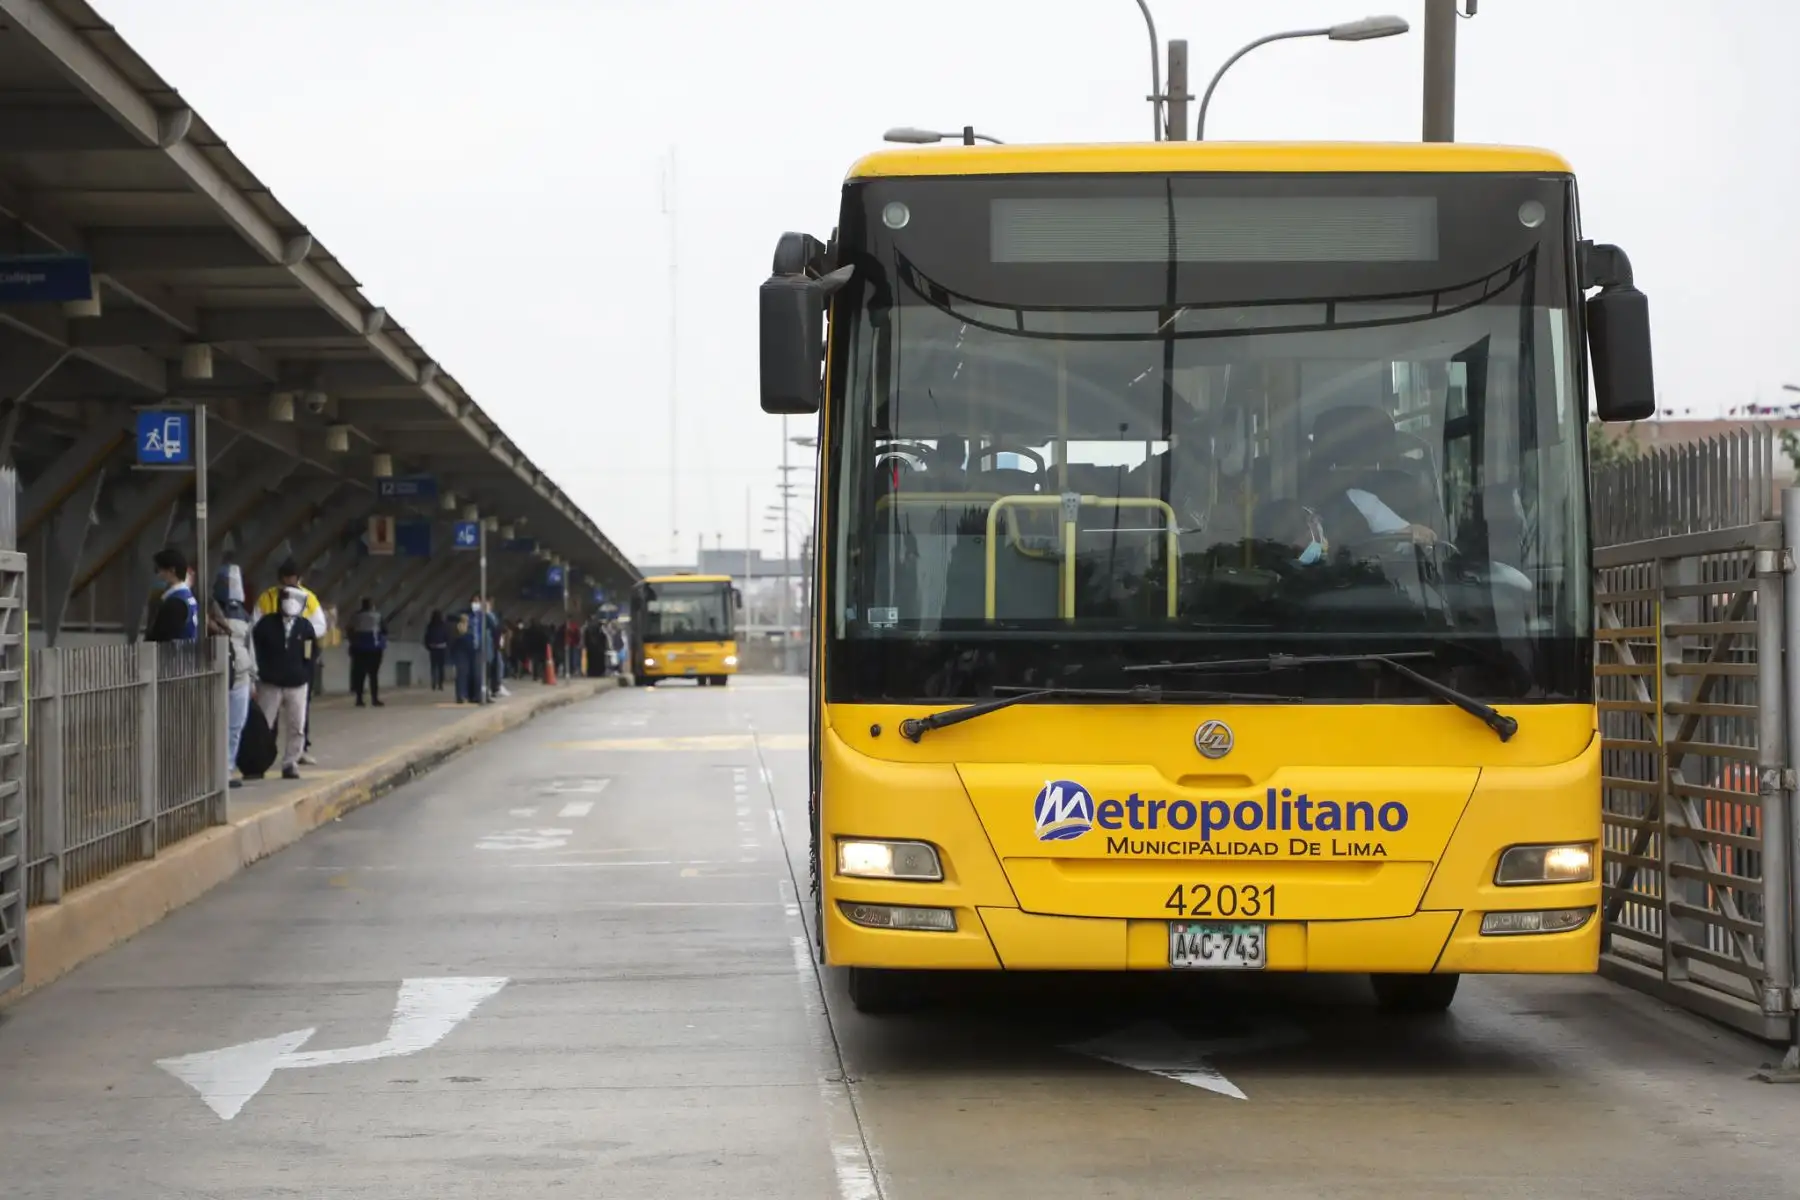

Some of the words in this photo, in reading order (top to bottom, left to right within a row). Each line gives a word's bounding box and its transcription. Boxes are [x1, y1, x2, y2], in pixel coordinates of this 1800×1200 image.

[1034, 780, 1409, 841] Metropolitano
[1107, 836, 1279, 856] MUNICIPALIDAD
[1332, 838, 1387, 856] LIMA
[1165, 884, 1275, 917] 42031
[1175, 932, 1260, 961] A4C-743
